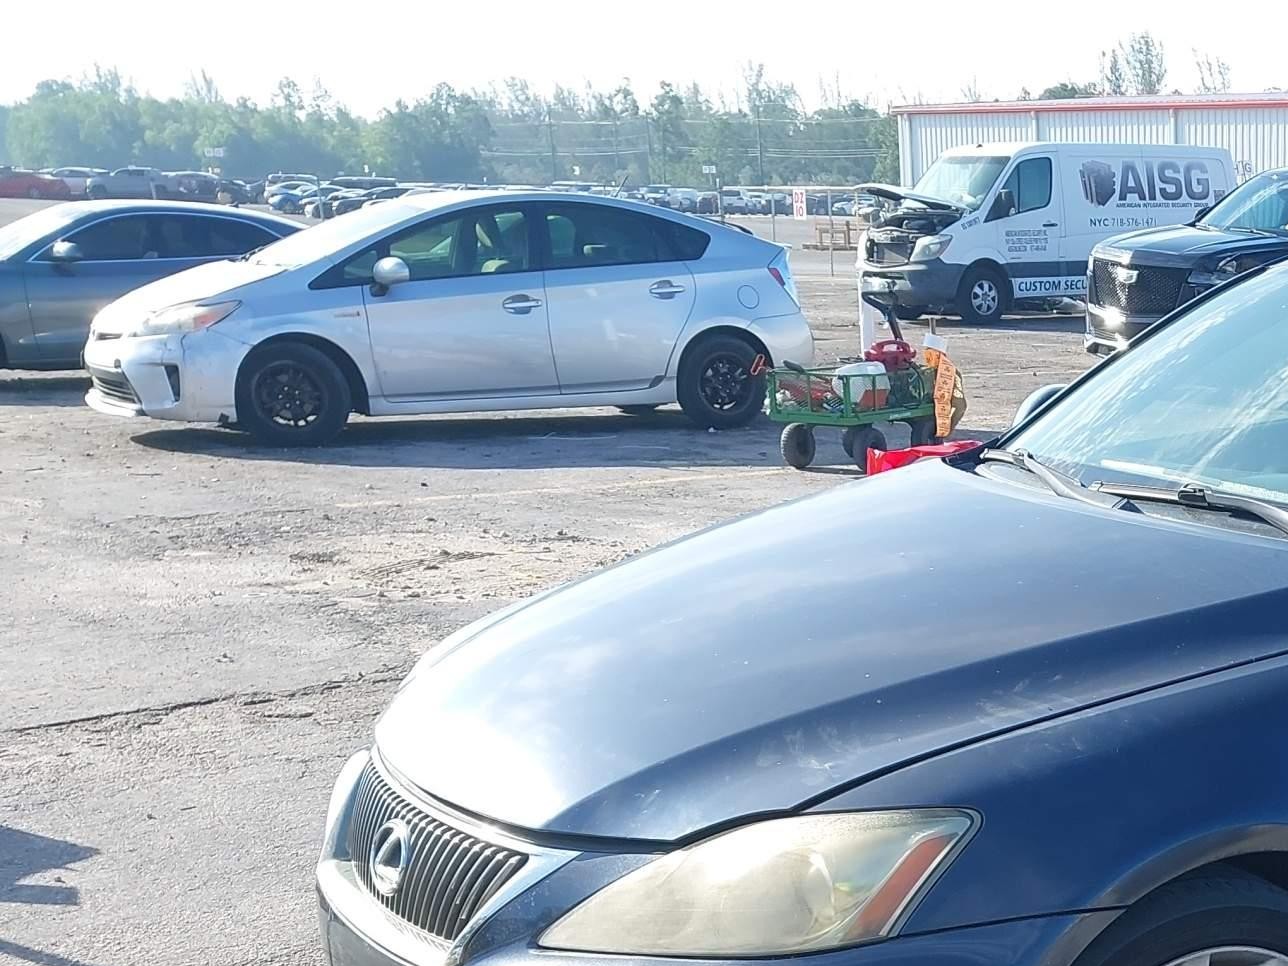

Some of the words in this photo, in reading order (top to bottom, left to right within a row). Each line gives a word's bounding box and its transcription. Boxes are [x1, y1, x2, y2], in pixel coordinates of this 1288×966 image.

[1118, 161, 1210, 201] AISG
[1089, 217, 1110, 227] NYC
[1018, 281, 1061, 292] CUSTOM
